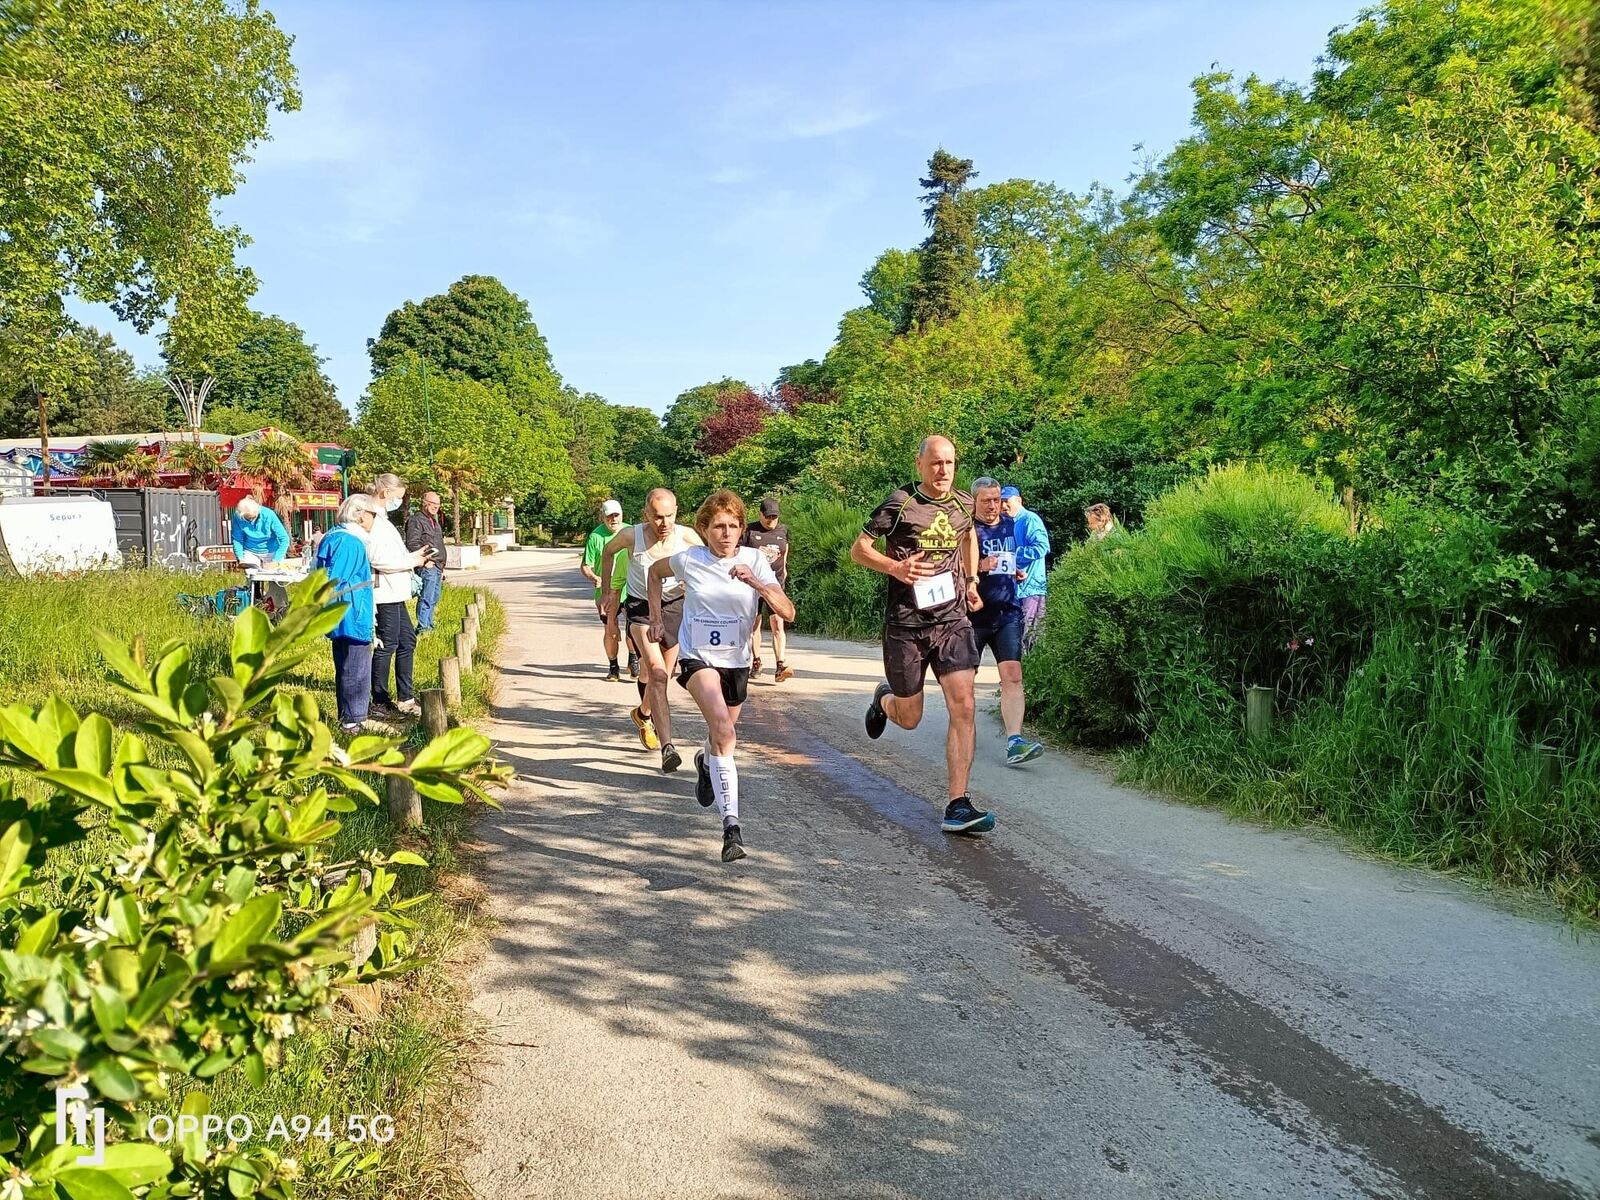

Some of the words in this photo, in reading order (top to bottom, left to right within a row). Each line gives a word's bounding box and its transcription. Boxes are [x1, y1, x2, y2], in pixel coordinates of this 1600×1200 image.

[1001, 560, 1009, 573] 5
[927, 584, 945, 603] 11
[709, 630, 721, 646] 8
